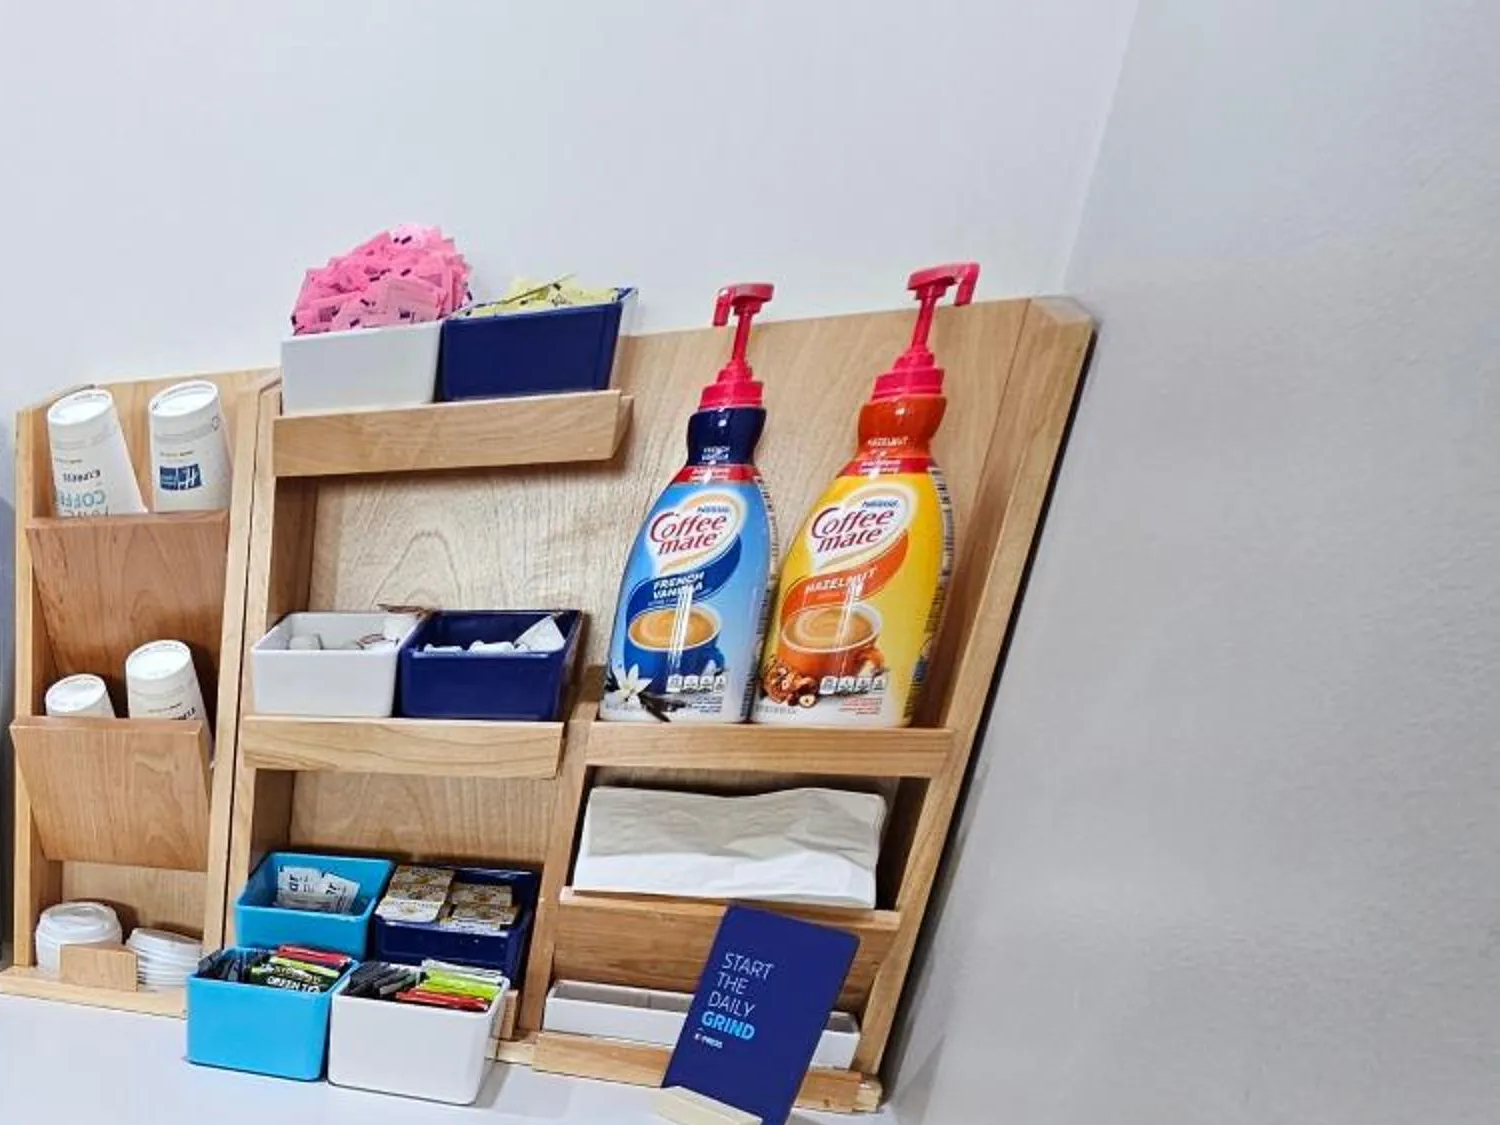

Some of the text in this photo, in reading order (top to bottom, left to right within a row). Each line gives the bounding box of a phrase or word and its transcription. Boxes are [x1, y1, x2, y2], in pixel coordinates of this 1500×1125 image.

[650, 511, 726, 542] Coffee
[812, 507, 894, 539] Coffee
[658, 533, 717, 556] mate
[818, 527, 882, 553] mate
[653, 571, 705, 588] FRENCH
[721, 952, 775, 980] START
[716, 971, 749, 995] THE
[708, 990, 756, 1018] DAILY
[701, 1011, 756, 1041] GRIND
